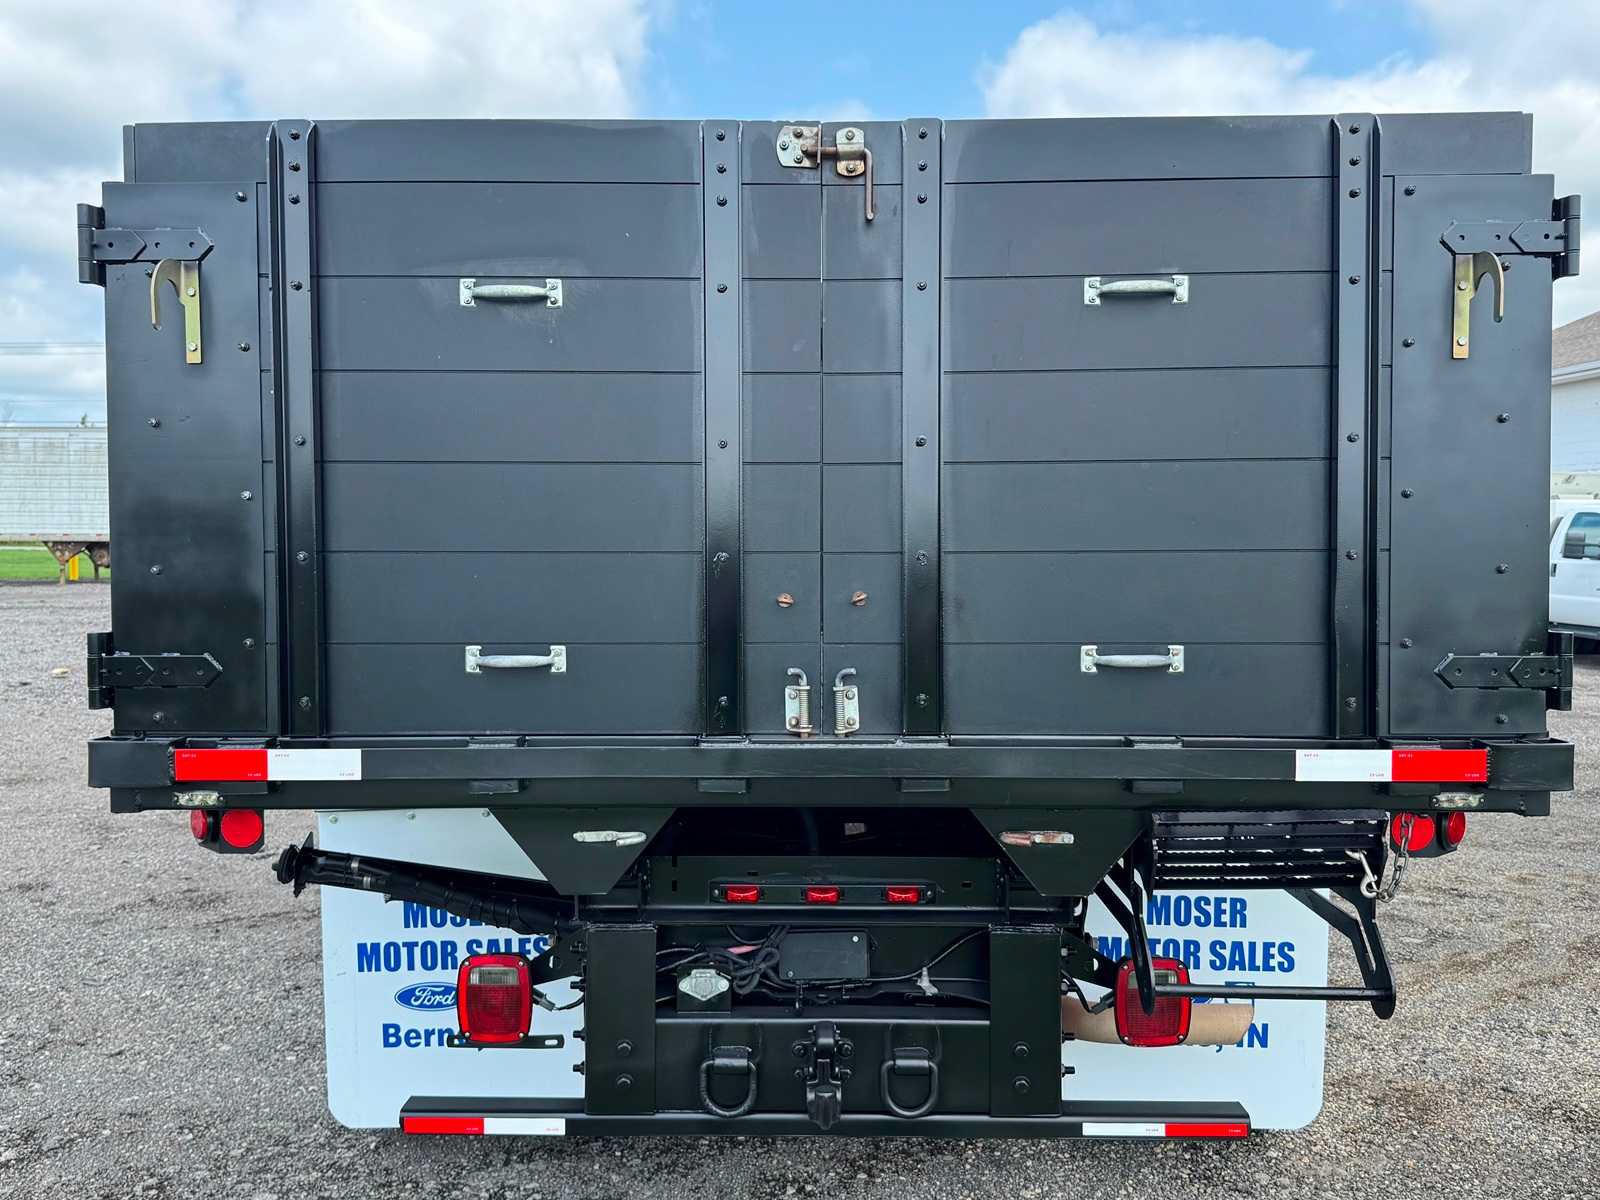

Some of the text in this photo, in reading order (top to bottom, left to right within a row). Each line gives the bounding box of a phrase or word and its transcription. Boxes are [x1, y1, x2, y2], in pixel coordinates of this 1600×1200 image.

[1146, 895, 1247, 928] MOSER
[357, 940, 459, 972] MOTOR
[1209, 940, 1295, 973] SALES
